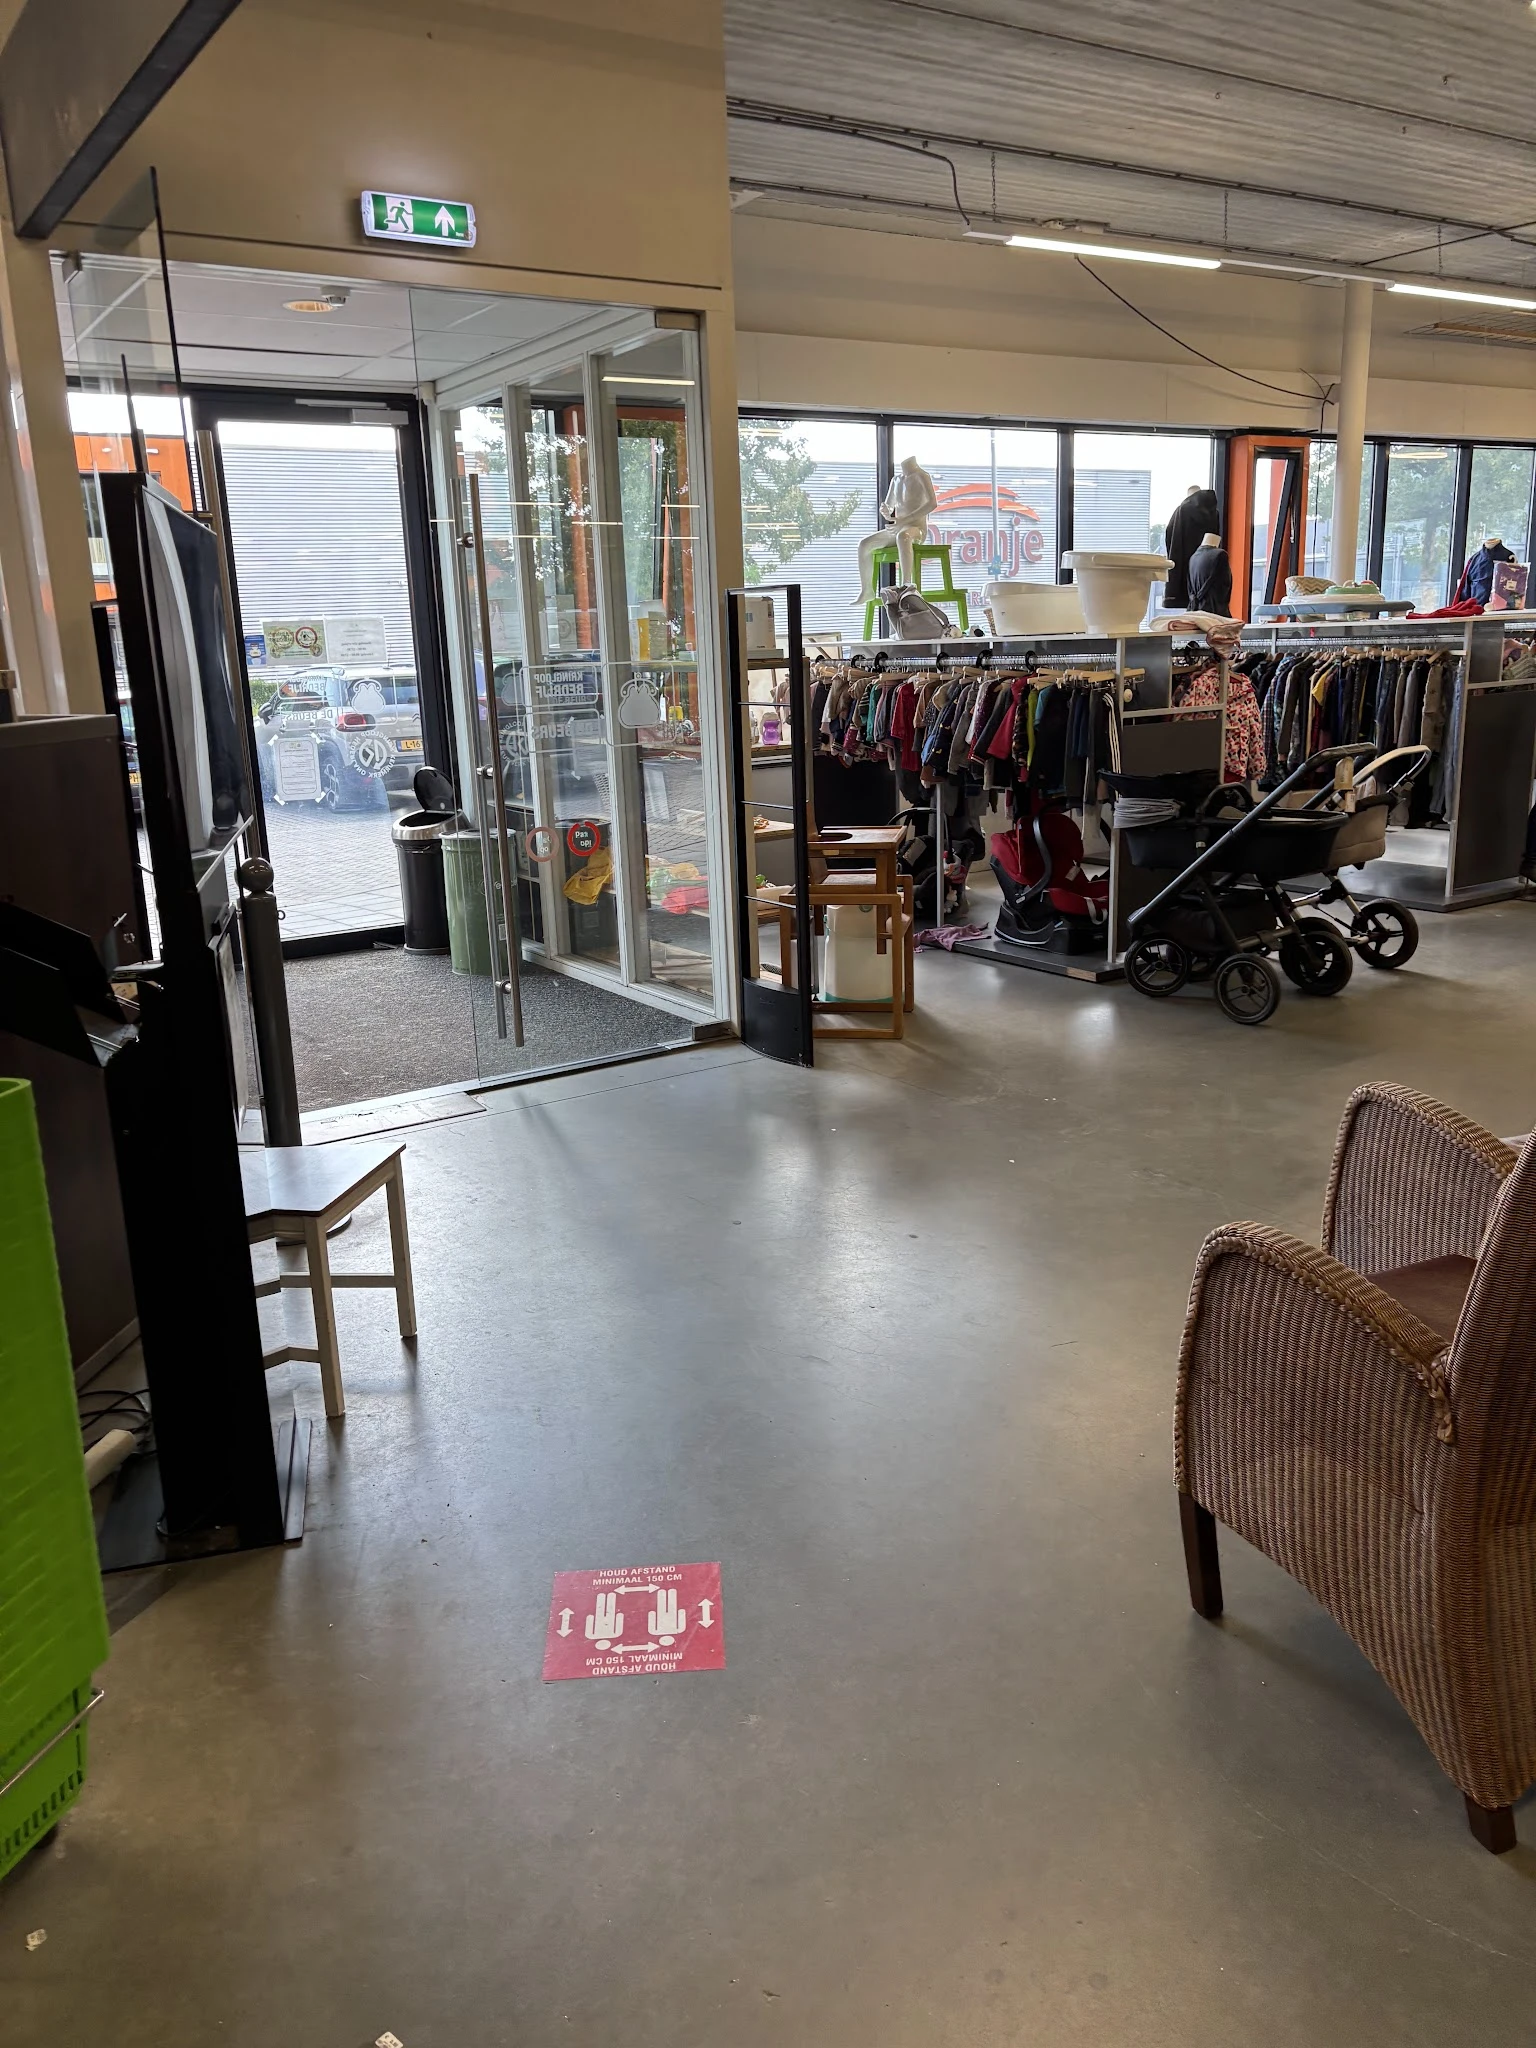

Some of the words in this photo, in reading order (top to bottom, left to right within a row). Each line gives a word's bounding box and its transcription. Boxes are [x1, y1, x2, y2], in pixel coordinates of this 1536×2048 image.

[405, 740, 423, 749] L-16
[600, 1569, 628, 1577] HOUD
[631, 1566, 676, 1575] AFSTAND
[592, 1577, 643, 1585] MINIMAAL
[586, 1657, 603, 1666] CM
[606, 1656, 625, 1664] 150
[628, 1652, 683, 1663] MINIMAAL
[592, 1665, 642, 1675] AFSTAND
[645, 1662, 676, 1672] HOUD
